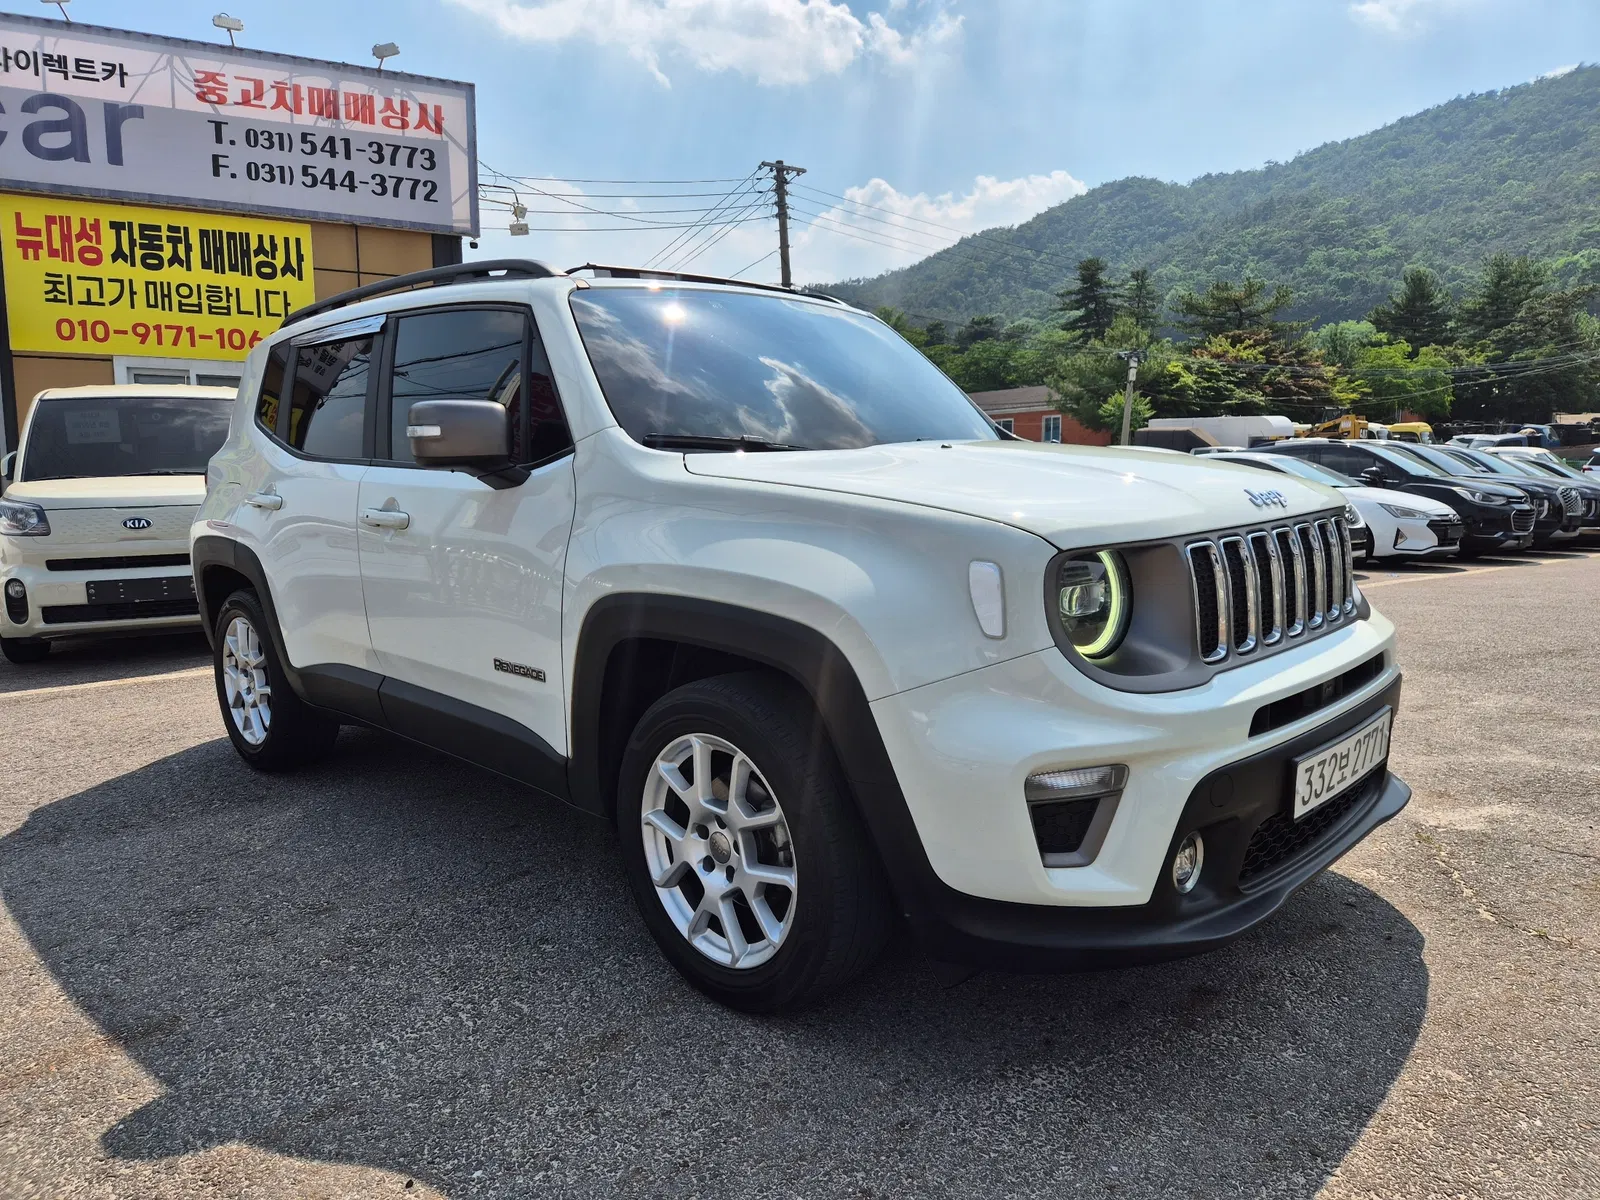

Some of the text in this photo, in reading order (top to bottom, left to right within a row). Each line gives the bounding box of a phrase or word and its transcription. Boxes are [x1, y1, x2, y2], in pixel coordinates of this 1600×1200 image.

[194, 69, 444, 135] 중고차매매상사
[0, 93, 144, 166] ar
[207, 119, 437, 171] T. 031) 541-3773
[211, 154, 438, 203] F. 031) 544-3772
[14, 211, 304, 281] 뉴대성 자동차 매매상사
[44, 272, 292, 318] 최고가 매입합니다
[56, 318, 275, 351] 010-9171-106
[1243, 488, 1288, 508] Jeep
[126, 519, 148, 528] KIA
[493, 657, 546, 683] RENEGADE
